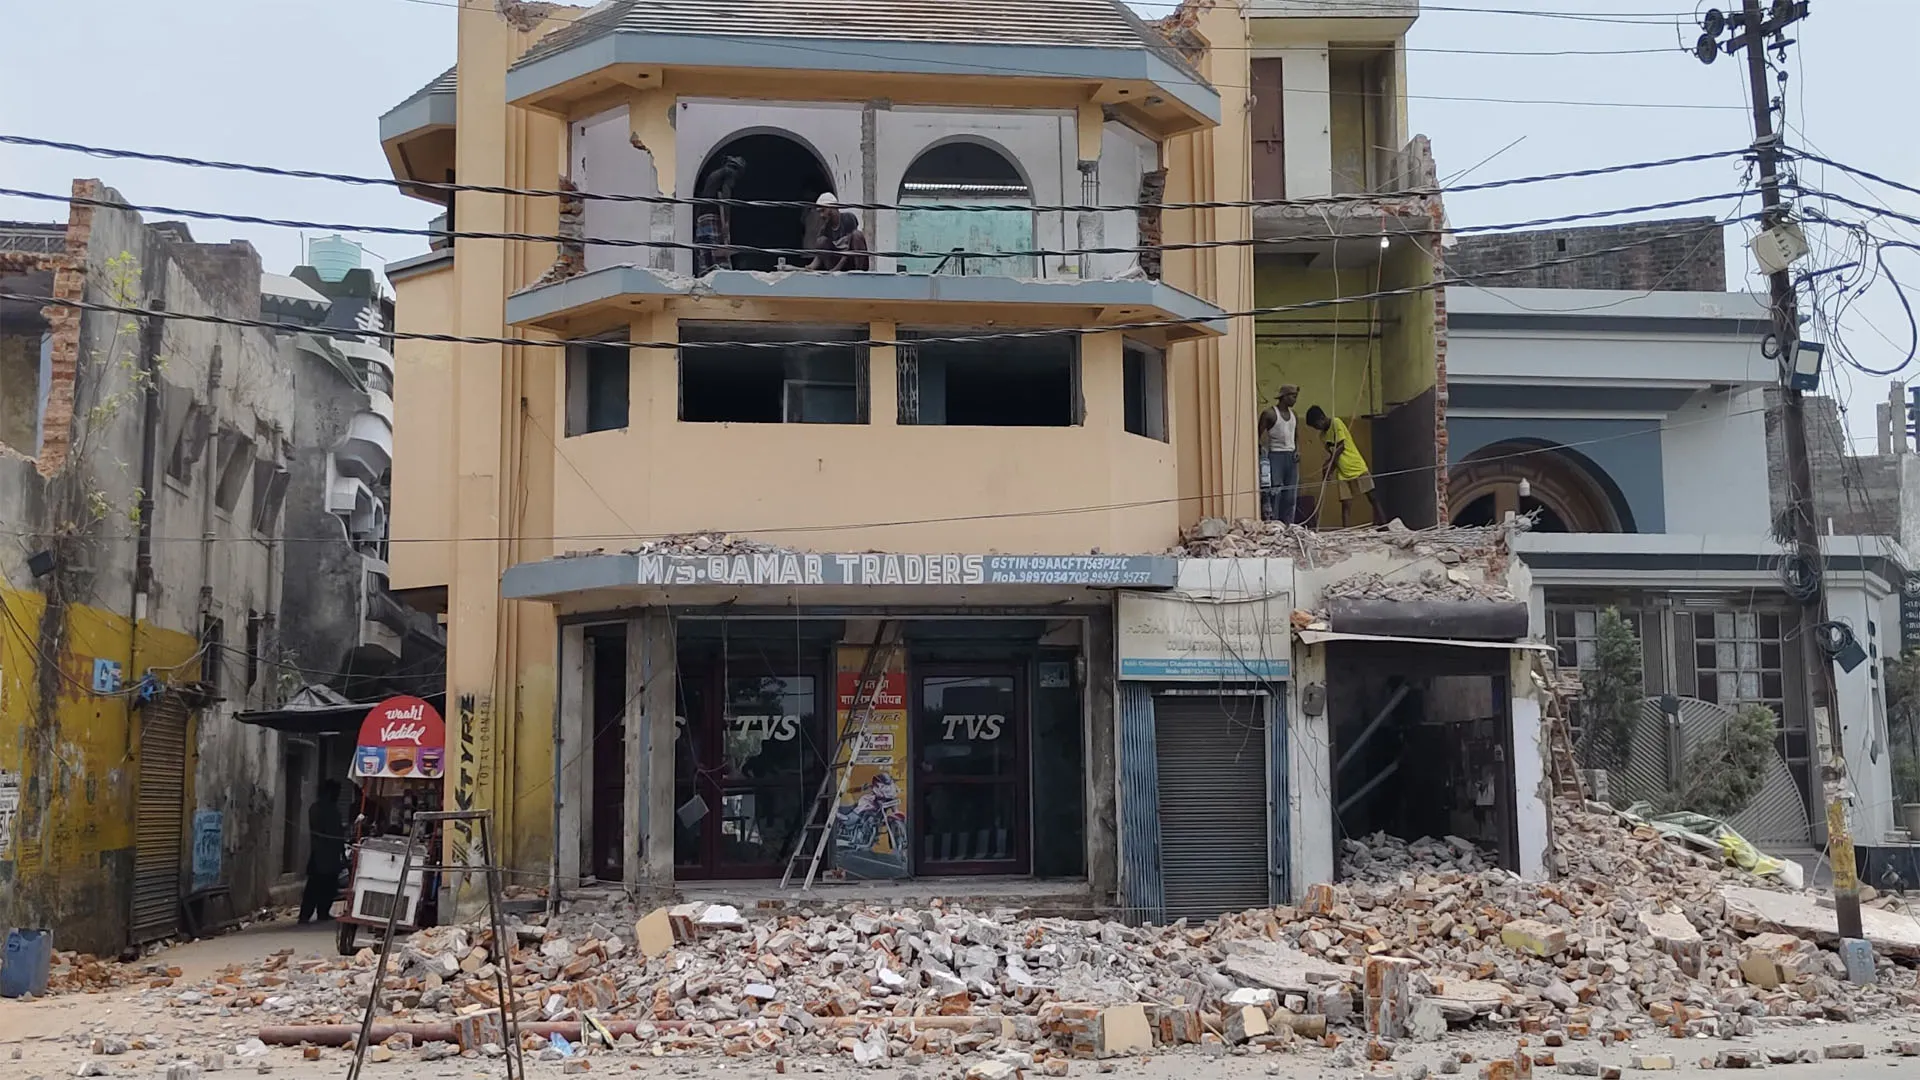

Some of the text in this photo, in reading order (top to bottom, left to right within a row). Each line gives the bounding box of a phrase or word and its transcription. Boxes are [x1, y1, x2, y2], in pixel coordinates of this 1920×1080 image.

[835, 554, 984, 585] TRADERS
[381, 722, 426, 745] Vadilal
[735, 715, 800, 741] TVS
[941, 714, 1005, 741] TVS
